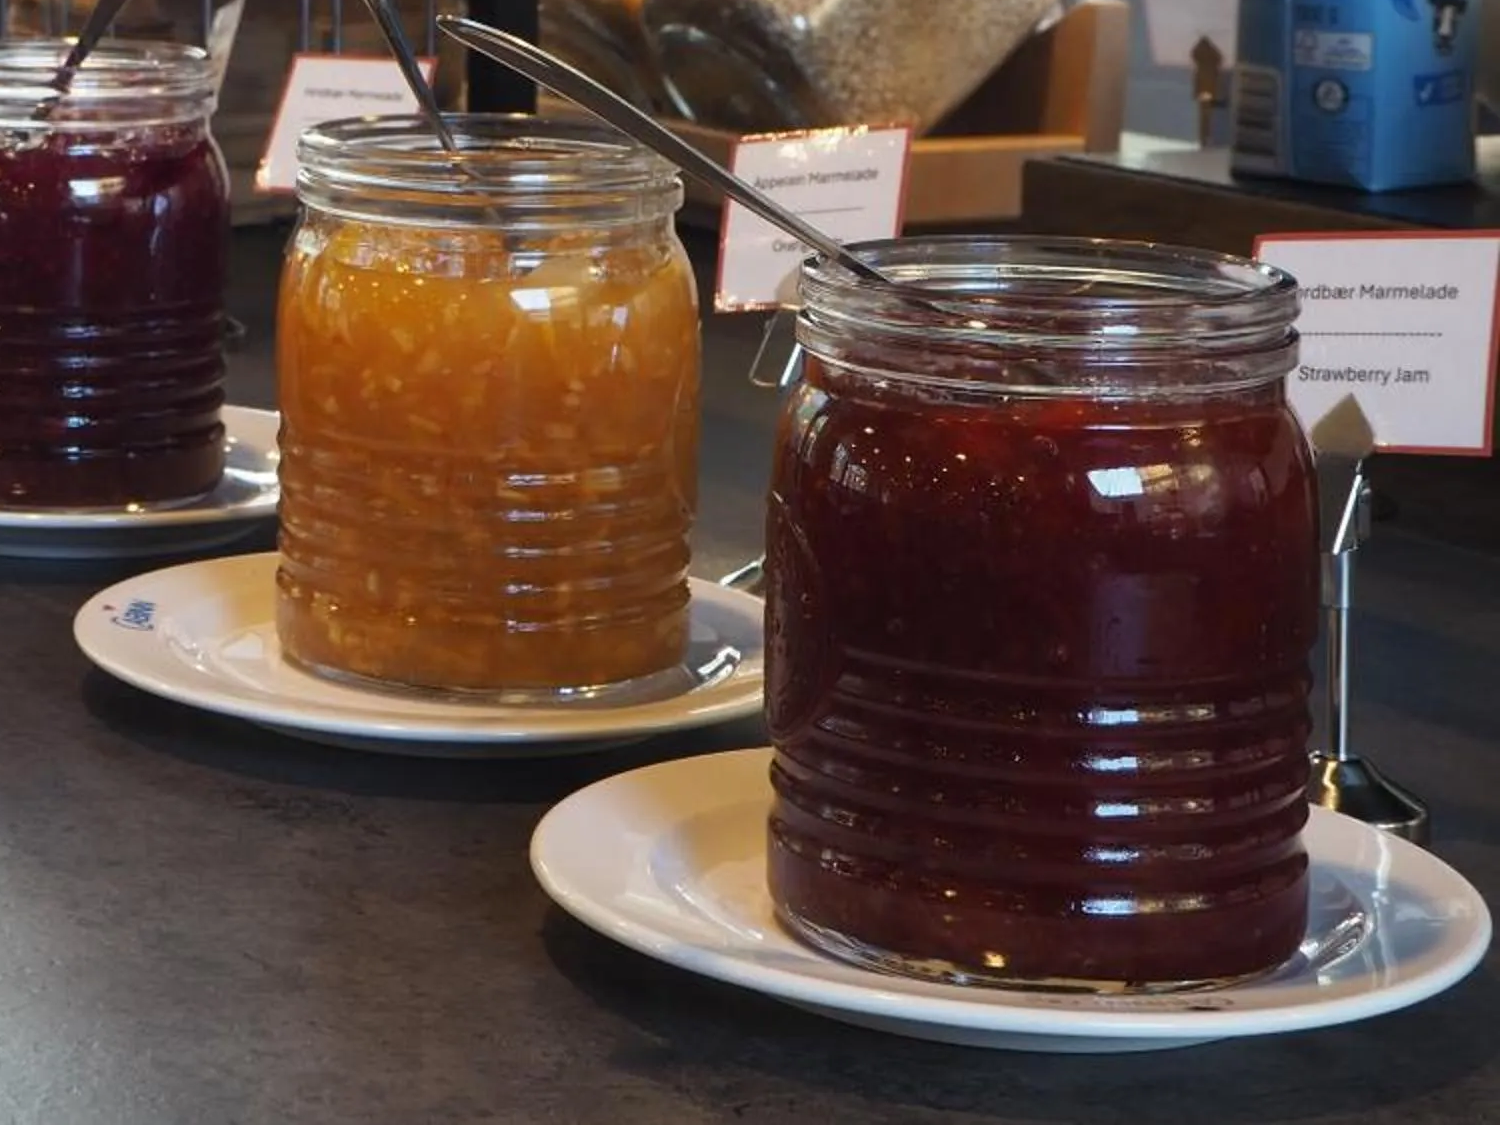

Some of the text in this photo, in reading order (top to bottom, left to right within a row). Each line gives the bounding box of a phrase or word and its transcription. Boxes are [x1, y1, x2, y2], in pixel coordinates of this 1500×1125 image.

[1359, 283, 1459, 300] Marmelade
[1298, 364, 1430, 386] Strawberry Jam
